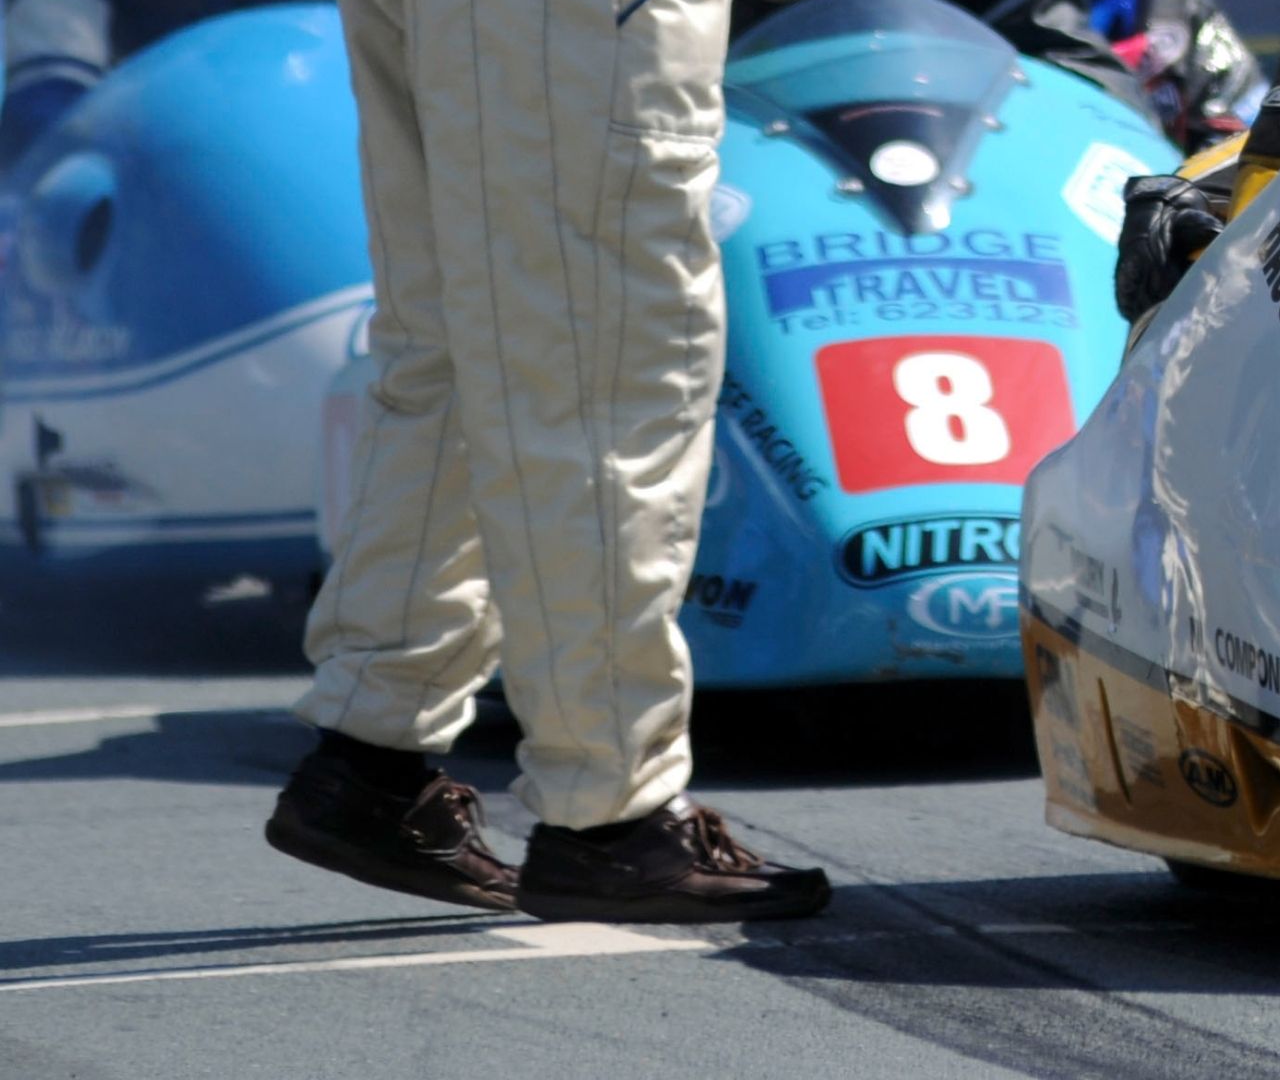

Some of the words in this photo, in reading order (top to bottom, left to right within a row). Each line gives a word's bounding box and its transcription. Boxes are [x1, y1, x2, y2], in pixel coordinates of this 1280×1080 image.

[755, 230, 1065, 270] BRIDGE
[812, 271, 1036, 306] TRAVEL
[874, 301, 1081, 329] 623123
[894, 350, 1011, 466] 8
[740, 407, 829, 503] RACING
